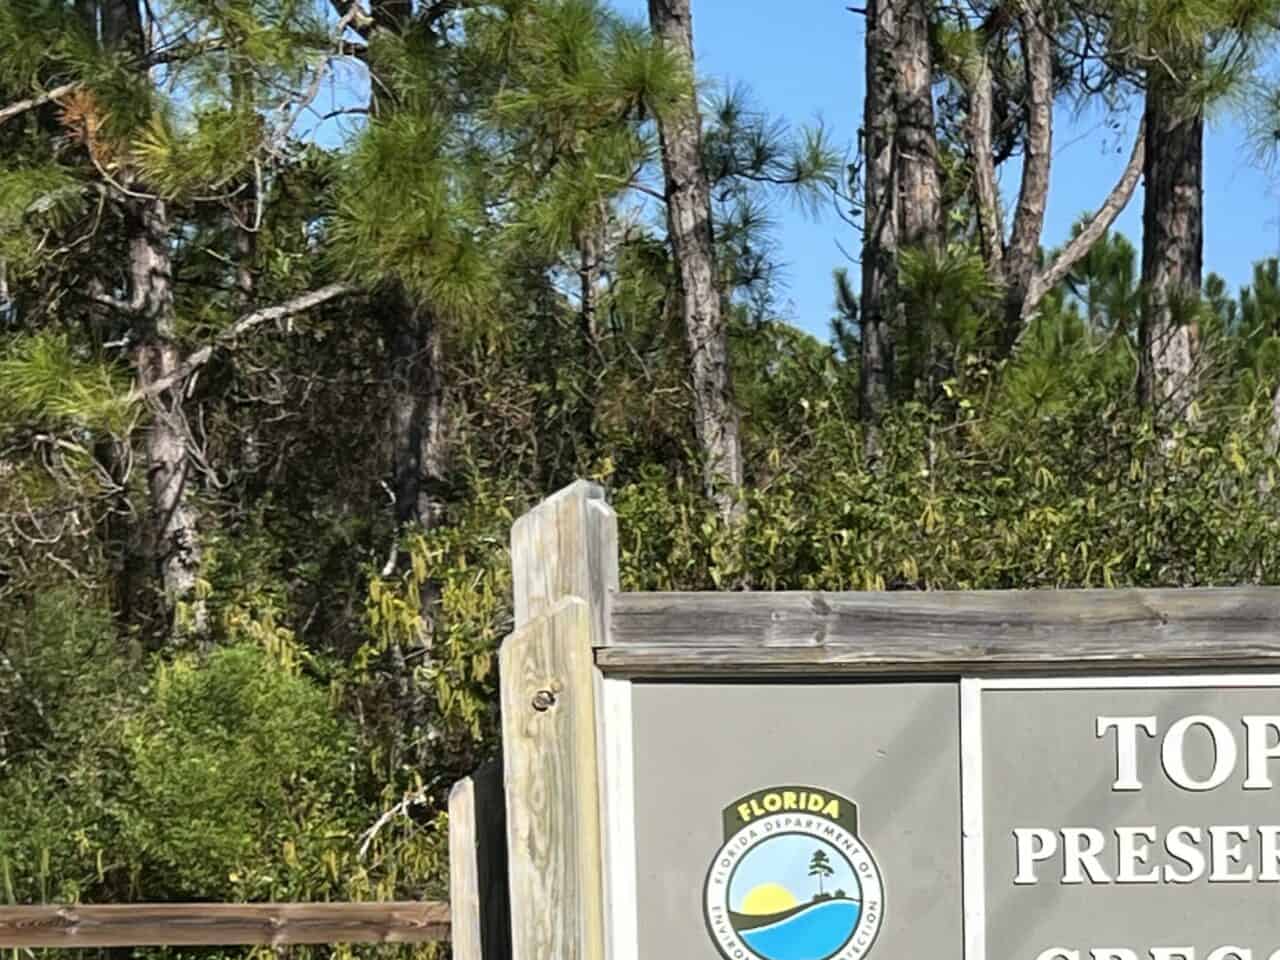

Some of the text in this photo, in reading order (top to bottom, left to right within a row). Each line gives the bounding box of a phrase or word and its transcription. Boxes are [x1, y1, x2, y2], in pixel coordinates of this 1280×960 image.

[736, 790, 842, 822] FLORIDA
[714, 816, 874, 885] FLORIDA DEPARTMENT OF
